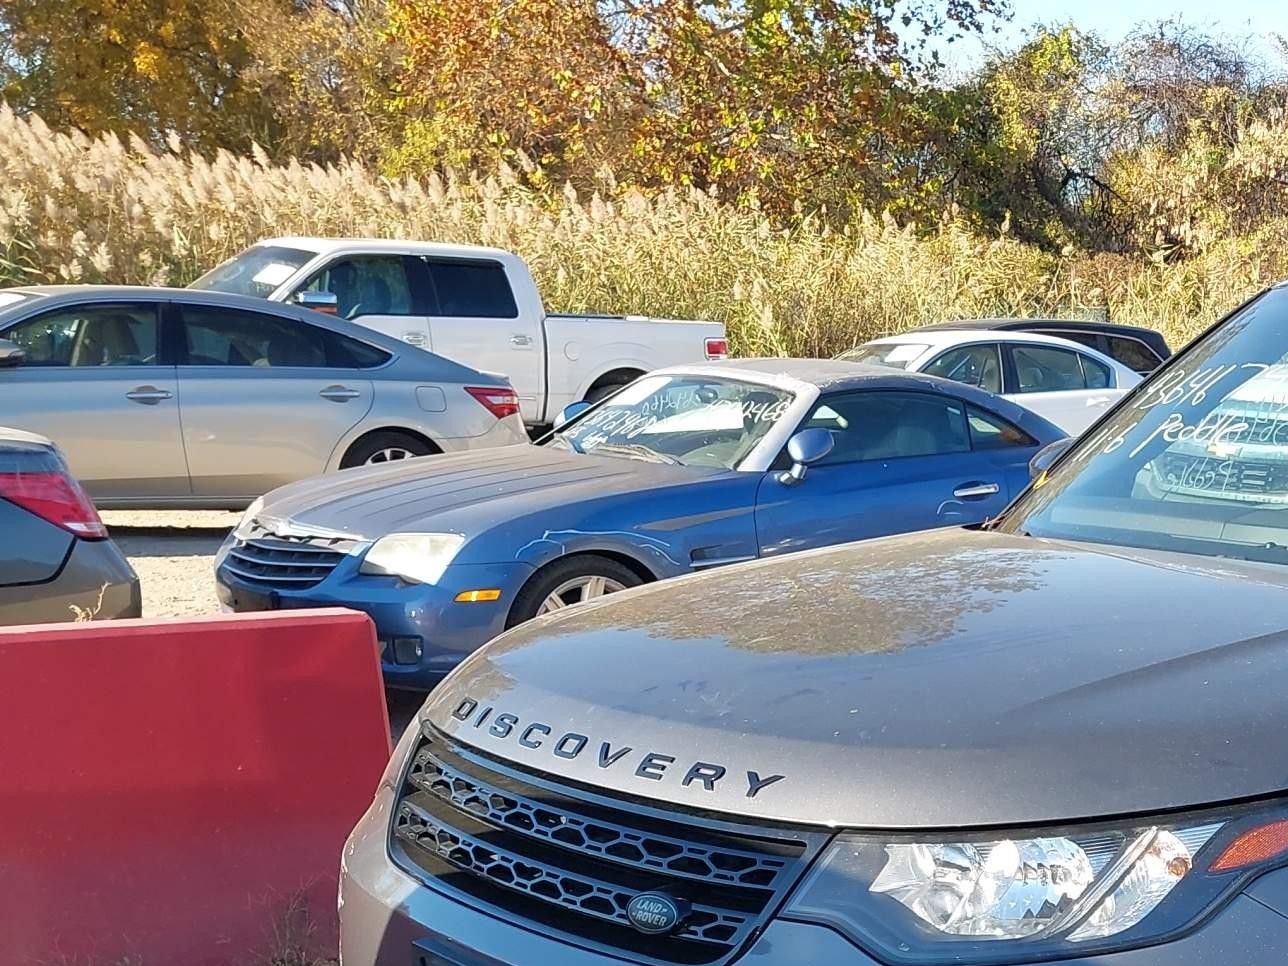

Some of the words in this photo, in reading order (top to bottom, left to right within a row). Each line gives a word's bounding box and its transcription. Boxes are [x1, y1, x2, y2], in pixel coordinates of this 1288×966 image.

[452, 696, 787, 800] DISCOVERY
[636, 899, 663, 913] LAND
[635, 910, 668, 927] ROVER
